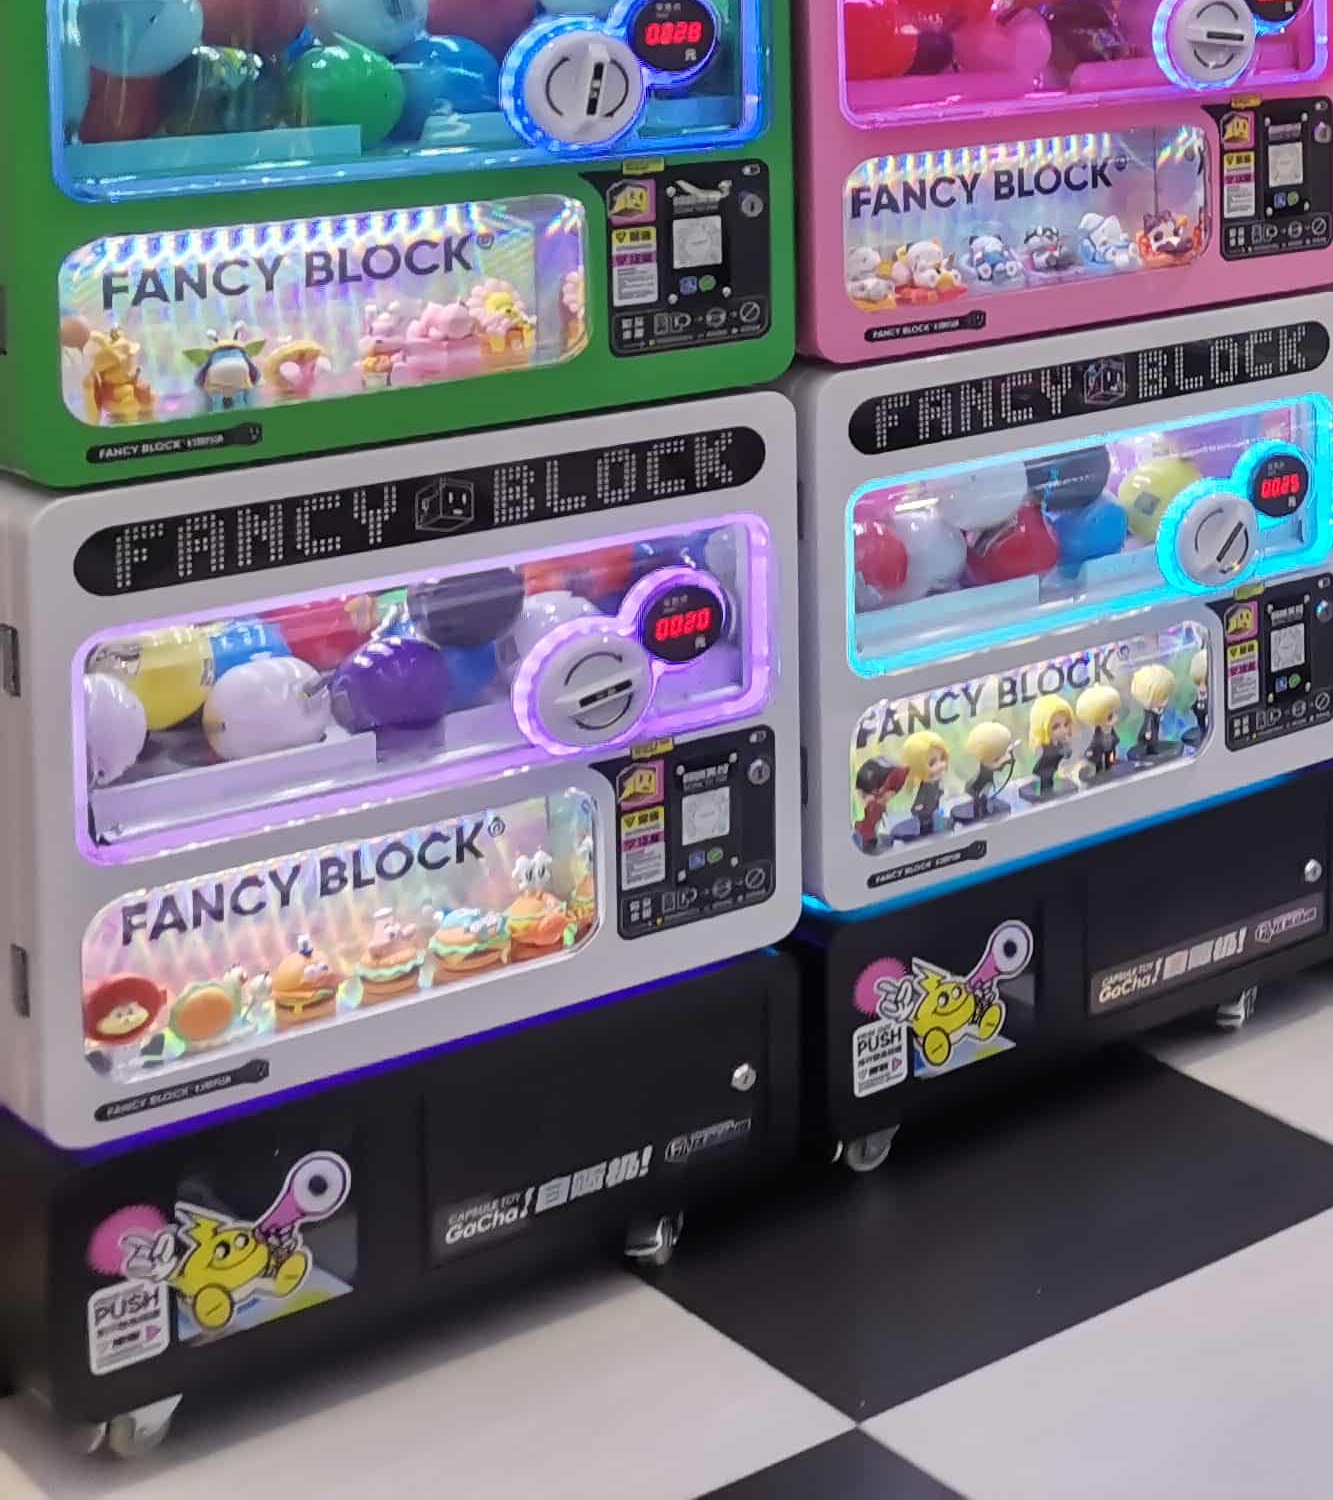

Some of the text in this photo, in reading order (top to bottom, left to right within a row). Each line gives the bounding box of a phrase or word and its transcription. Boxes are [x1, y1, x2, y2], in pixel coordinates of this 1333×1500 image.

[850, 162, 1113, 219] FANCY BLOCK
[102, 235, 474, 311] FANCY BLOCK
[876, 327, 1307, 448] FANCY BLOCK
[99, 441, 181, 460] FANCY BLOCK
[114, 431, 733, 588] FANCY BLOCK
[855, 646, 1116, 748] FANCY BLOCK
[120, 821, 484, 944] FANCY BLOCK
[857, 1029, 902, 1057] PUSH
[450, 1190, 522, 1227] CAPSULE TOY
[94, 1291, 161, 1322] PUSH
